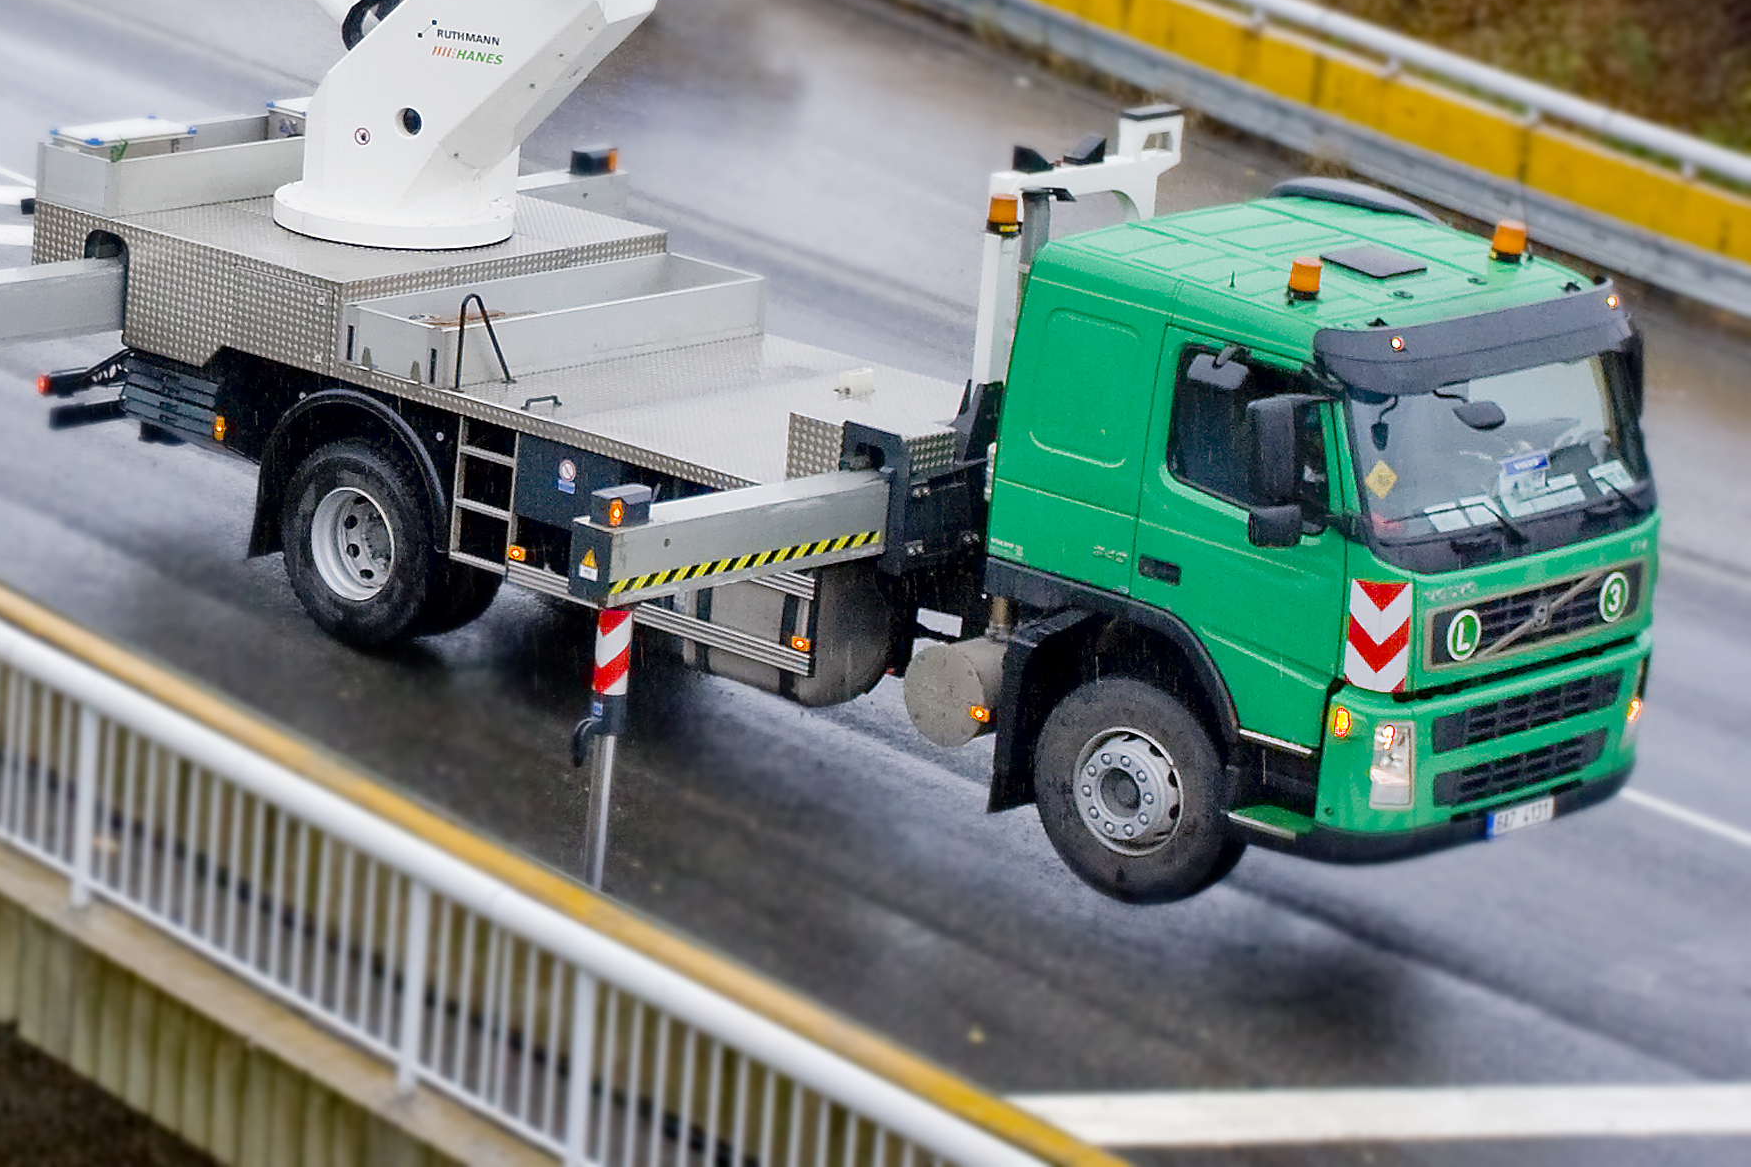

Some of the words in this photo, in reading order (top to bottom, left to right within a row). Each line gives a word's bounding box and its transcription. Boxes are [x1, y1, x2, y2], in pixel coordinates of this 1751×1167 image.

[436, 28, 501, 46] RUTHMANN
[455, 49, 504, 65] HANES
[1606, 581, 1621, 613] 3
[1456, 621, 1471, 652] L
